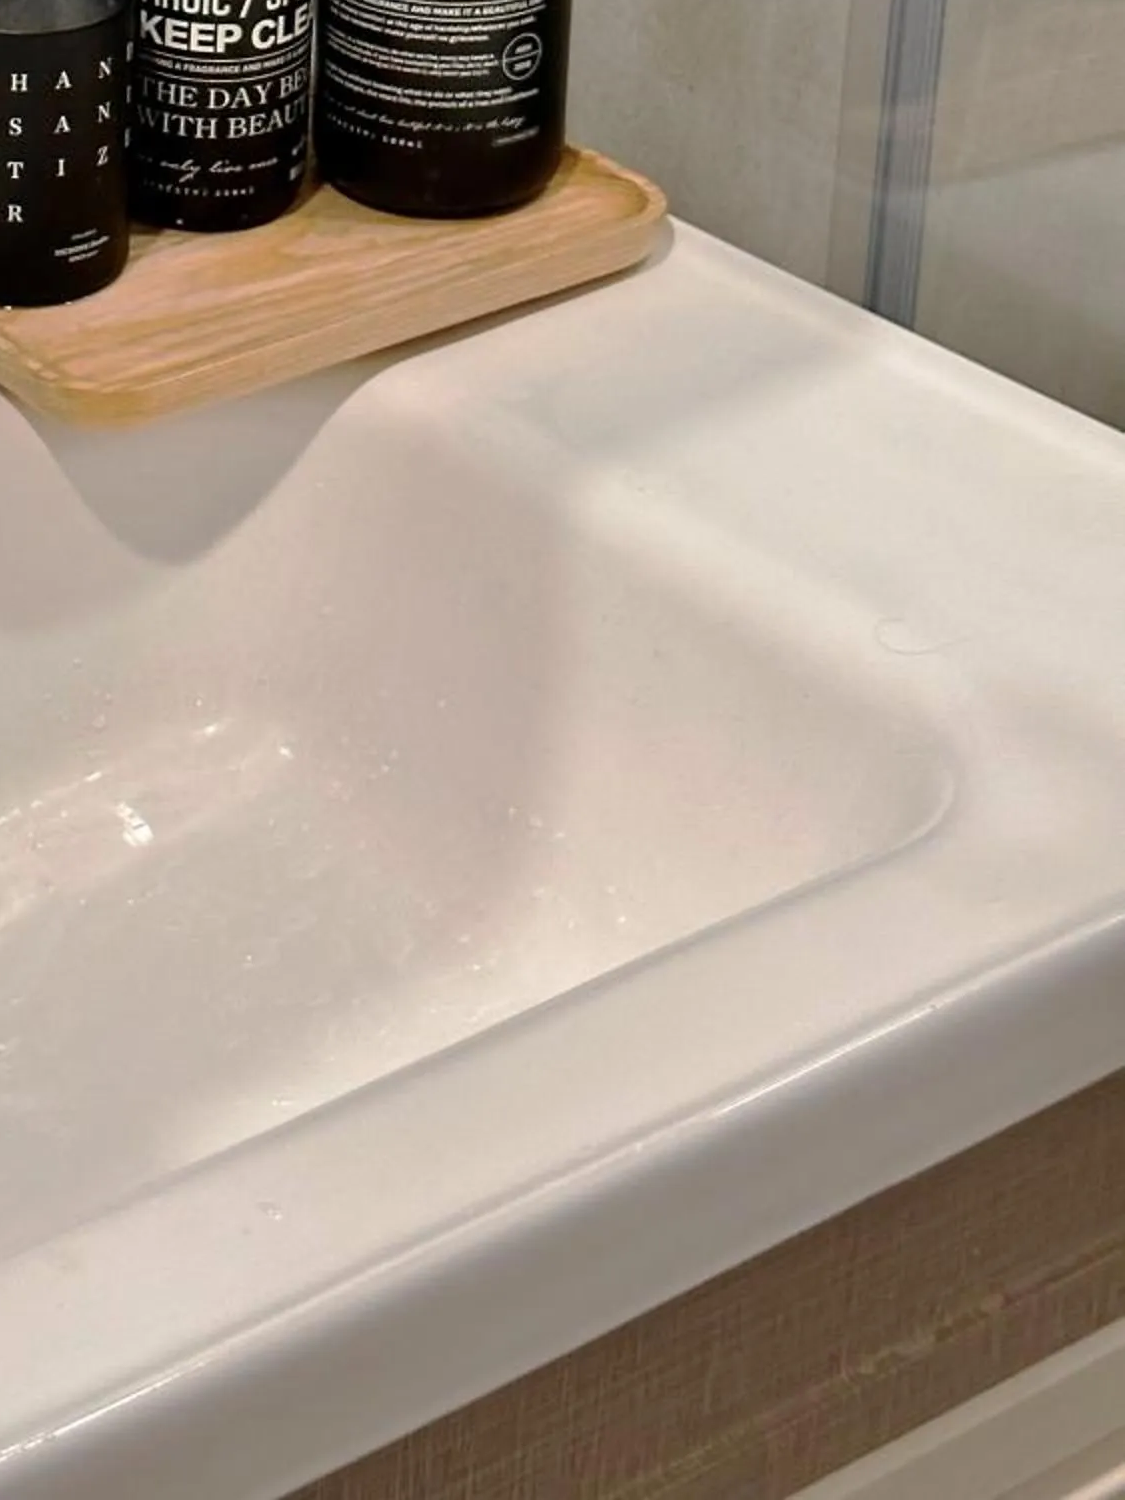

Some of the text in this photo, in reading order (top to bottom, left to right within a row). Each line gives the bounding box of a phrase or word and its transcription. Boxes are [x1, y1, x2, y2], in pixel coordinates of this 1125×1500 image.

[140, 9, 242, 53] KEEP
[142, 76, 198, 108] THE
[207, 82, 274, 109] DAY
[137, 104, 219, 139] WITH
